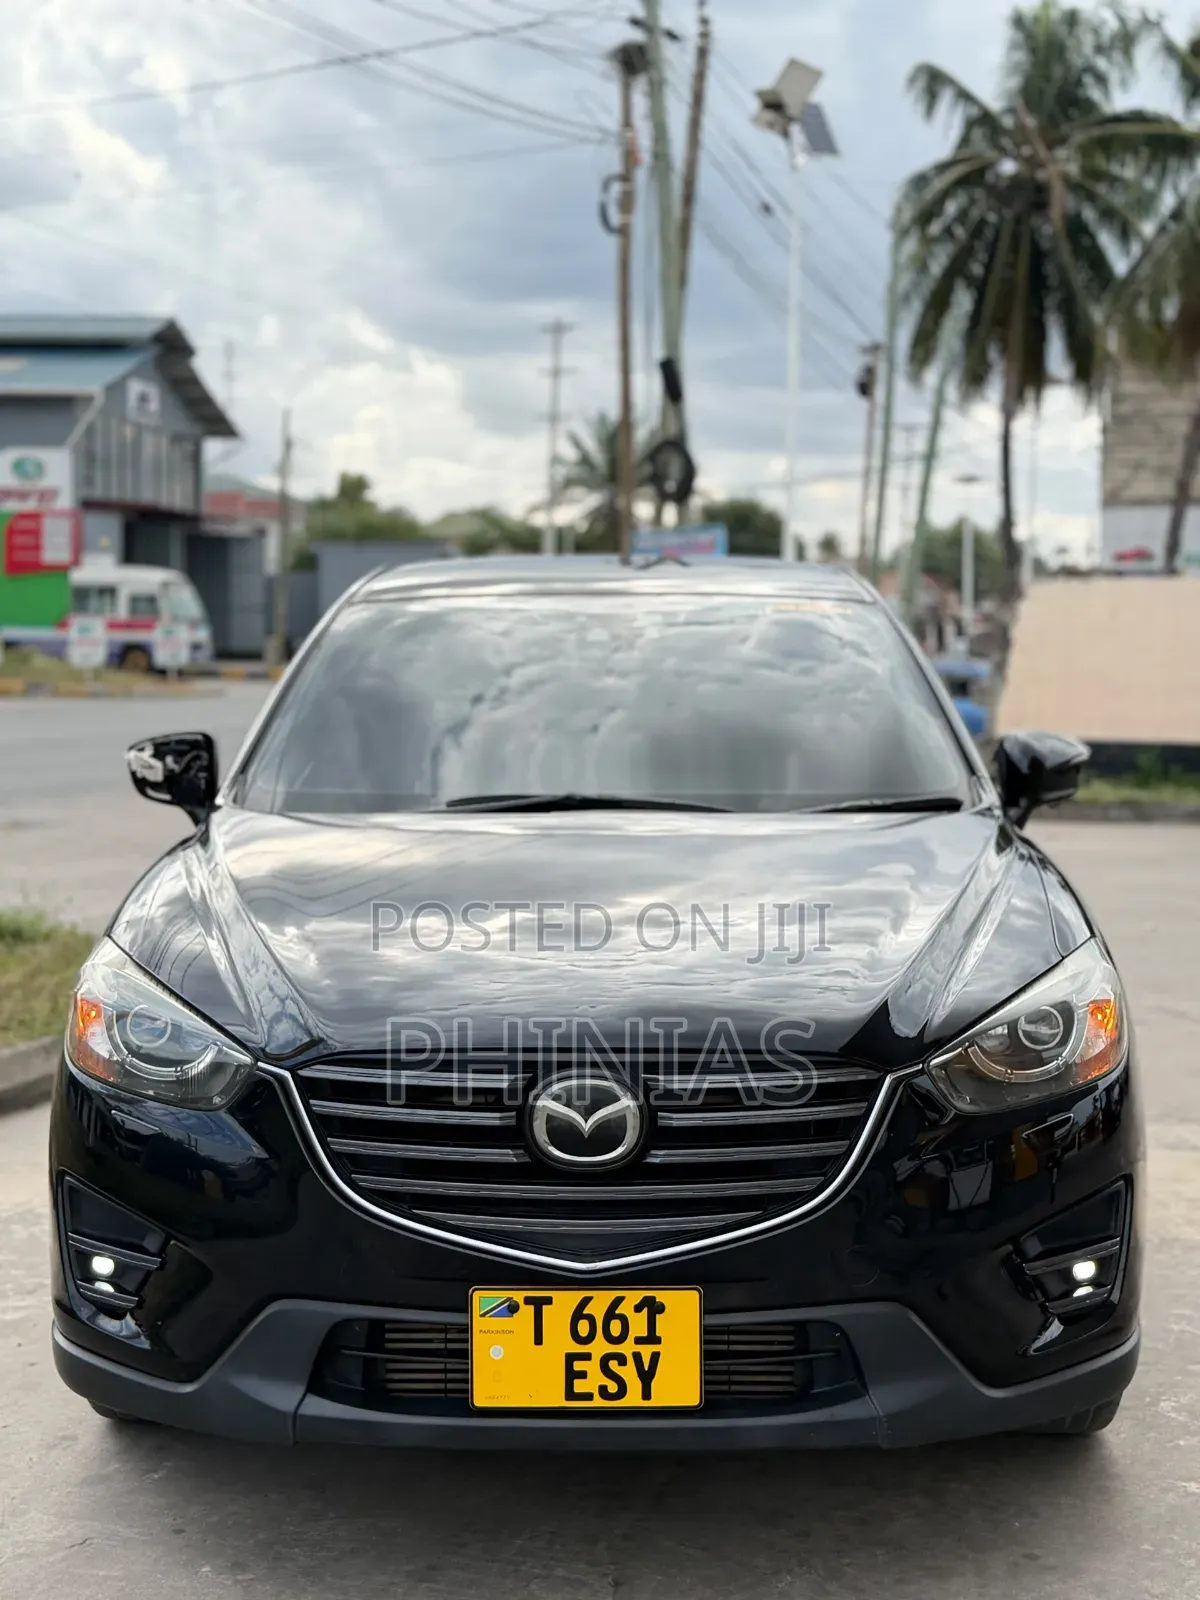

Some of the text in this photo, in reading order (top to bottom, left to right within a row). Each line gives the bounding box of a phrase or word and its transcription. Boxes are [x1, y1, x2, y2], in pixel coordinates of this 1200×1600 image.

[524, 1296, 662, 1345] T 661
[564, 1351, 661, 1402] ESY
